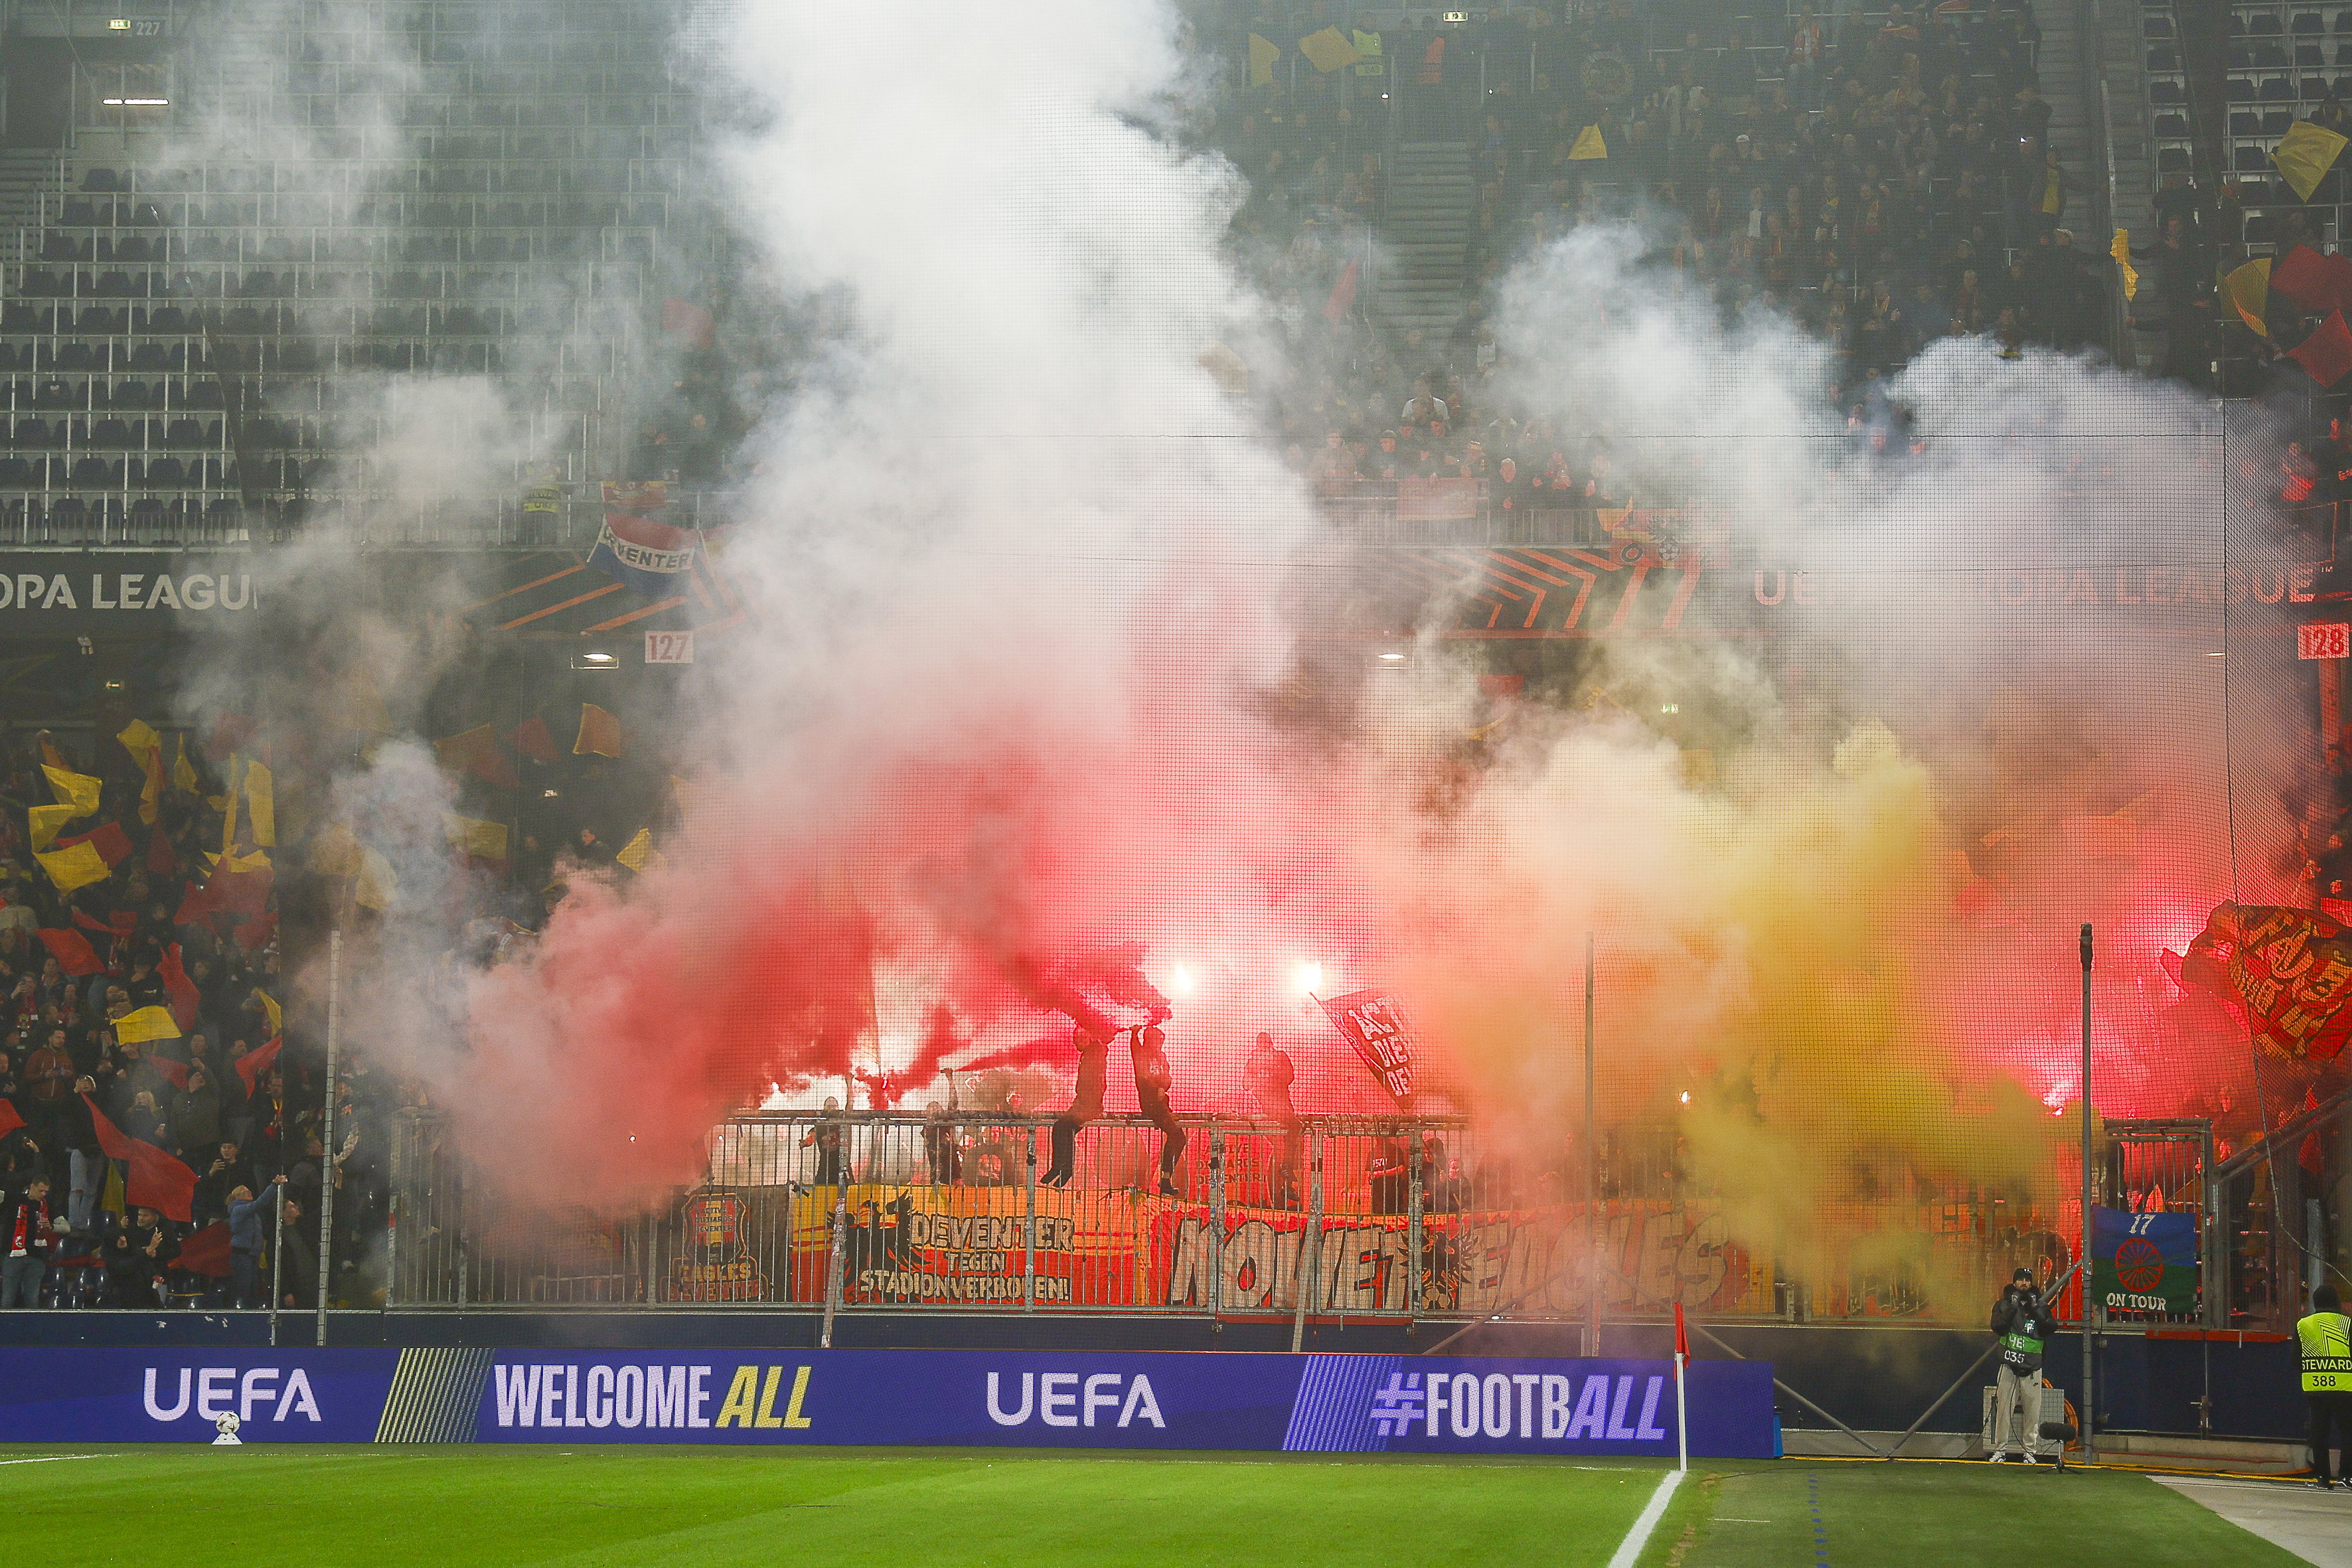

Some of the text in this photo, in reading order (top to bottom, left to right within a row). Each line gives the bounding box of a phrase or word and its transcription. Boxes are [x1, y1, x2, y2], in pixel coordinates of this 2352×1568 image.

[137, 21, 160, 35] 227
[92, 574, 259, 610] LEAGU
[647, 635, 690, 661] 127
[2304, 627, 2346, 656] 128
[909, 1215, 1074, 1250] DEVENTER
[2129, 1214, 2156, 1235] 17
[678, 1263, 751, 1282] EAGLES
[945, 1251, 1006, 1271] TEGEN
[860, 1270, 1069, 1300] STADIONVERBOEN!
[2106, 1293, 2167, 1311] ON TOUR
[2004, 1350, 2025, 1364] 035
[2312, 1375, 2336, 1387] 388
[143, 1368, 321, 1422] UEFA
[494, 1365, 813, 1429] WELCOME ALL
[986, 1372, 1166, 1429] UEFA
[1372, 1372, 1666, 1441] #FOOTBALL
